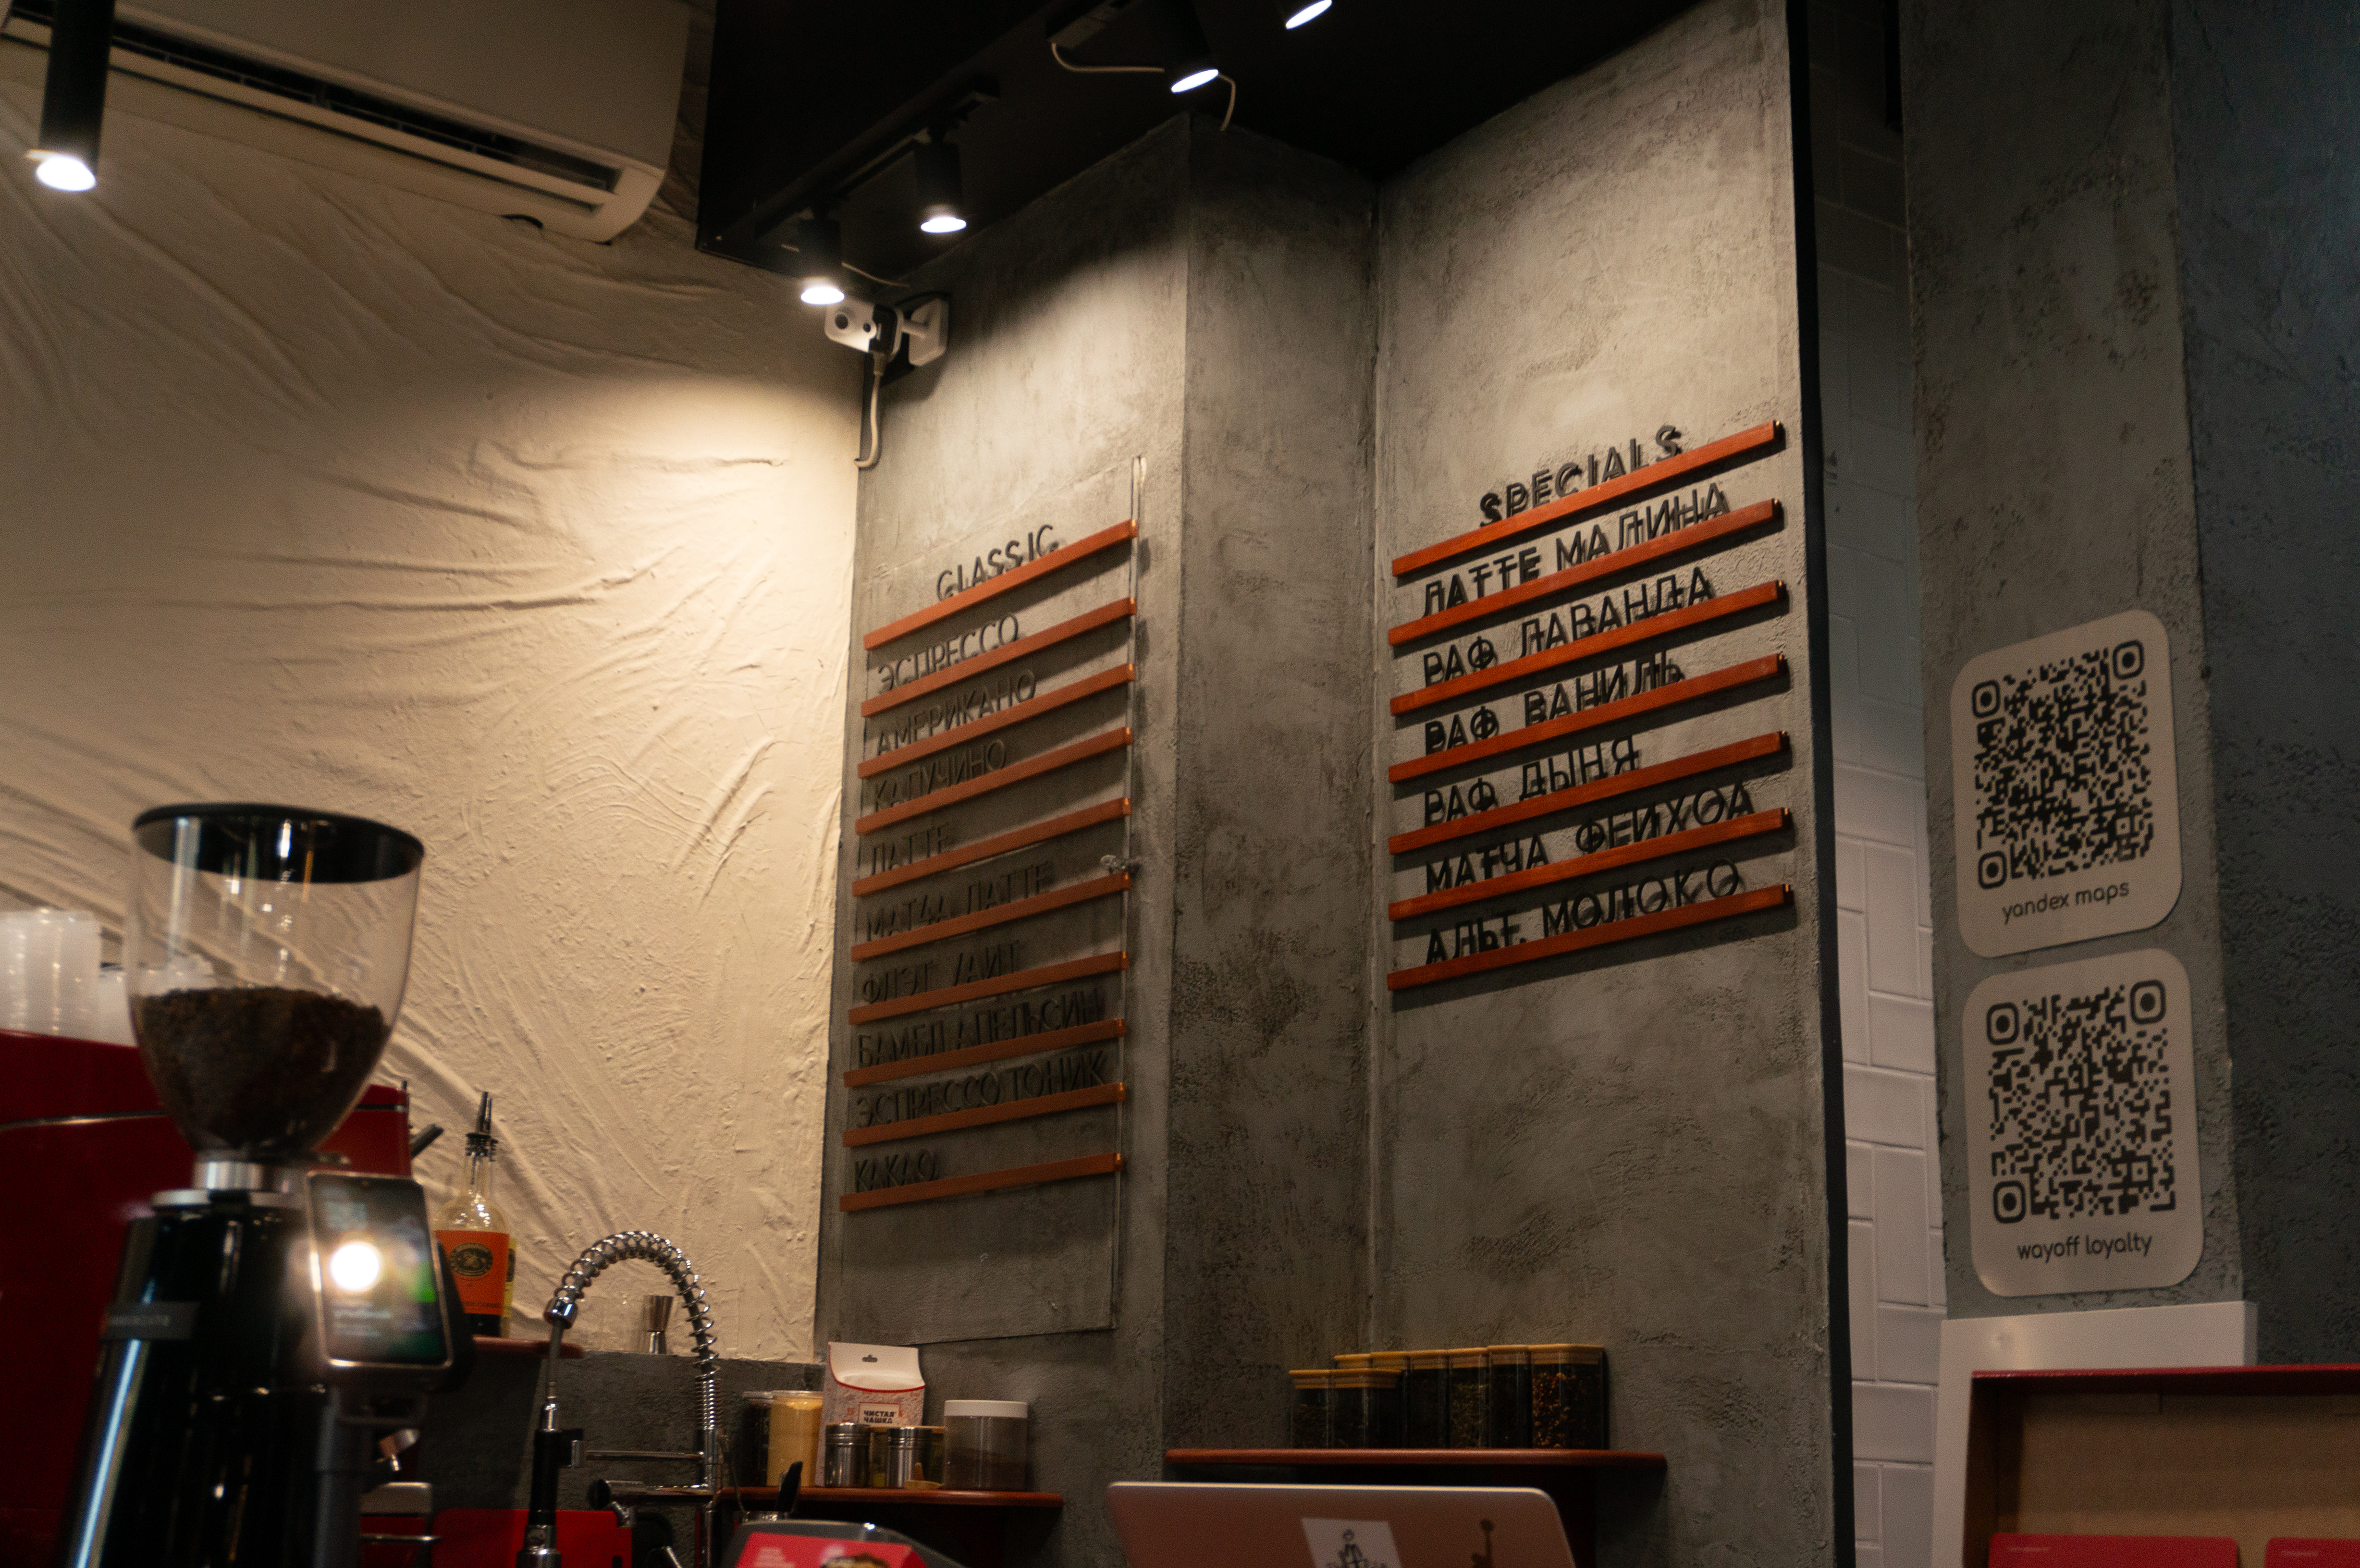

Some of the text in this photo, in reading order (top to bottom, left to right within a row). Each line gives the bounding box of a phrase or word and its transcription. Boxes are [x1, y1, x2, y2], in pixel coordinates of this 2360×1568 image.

[1479, 425, 1683, 527] SPECIALS
[936, 525, 1058, 601] CLASSIC
[1423, 482, 1729, 617] ЛАТТЕ МАЛИНА
[878, 614, 1018, 692] ЭСПРЕССО
[1423, 567, 1715, 686] РАФ ЛАВАНДА
[878, 669, 1035, 756] АМЕРИКАНО
[1425, 649, 1683, 755] РАФ ВАНИЛЬ
[875, 739, 1005, 811] КАПУЧИНО
[1424, 735, 1637, 828] РАФ ДЫНЯ
[872, 822, 949, 875] ЛАТТЕ
[1426, 833, 1548, 894] МАТЧА
[867, 861, 1049, 942] МАТЧА ЛАТТЕ
[1426, 859, 1738, 965] АЛЬТ. МОЛОКО
[2002, 882, 2129, 924] yandex maps
[862, 961, 934, 1004] ФЛЭТ
[957, 988, 1100, 1050] АПЕЛЬСИН
[857, 1050, 1105, 1128] ЭСПРЕССО ТОНИК
[854, 1149, 936, 1193] КАКАО
[2017, 1232, 2152, 1263] wayoff loyalty
